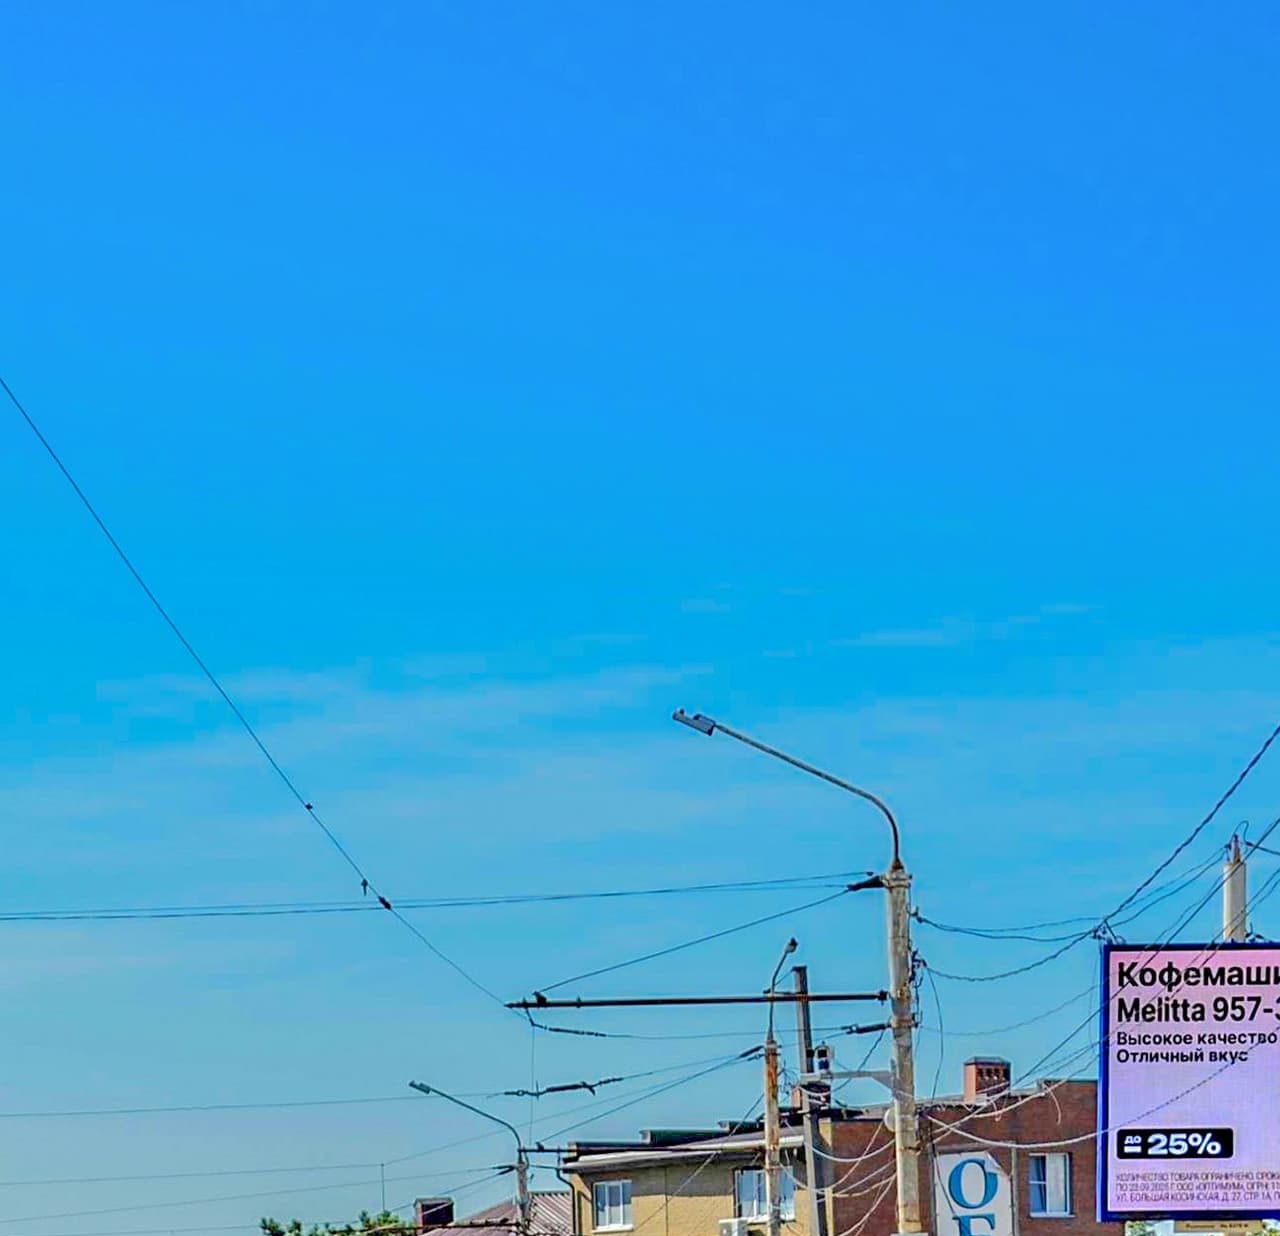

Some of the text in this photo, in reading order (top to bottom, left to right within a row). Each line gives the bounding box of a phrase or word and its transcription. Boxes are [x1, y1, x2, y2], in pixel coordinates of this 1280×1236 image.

[1117, 998, 1206, 1022] Melitta
[1117, 1032, 1278, 1046] Высокое качество
[1117, 1049, 1249, 1065] Отличный вкус
